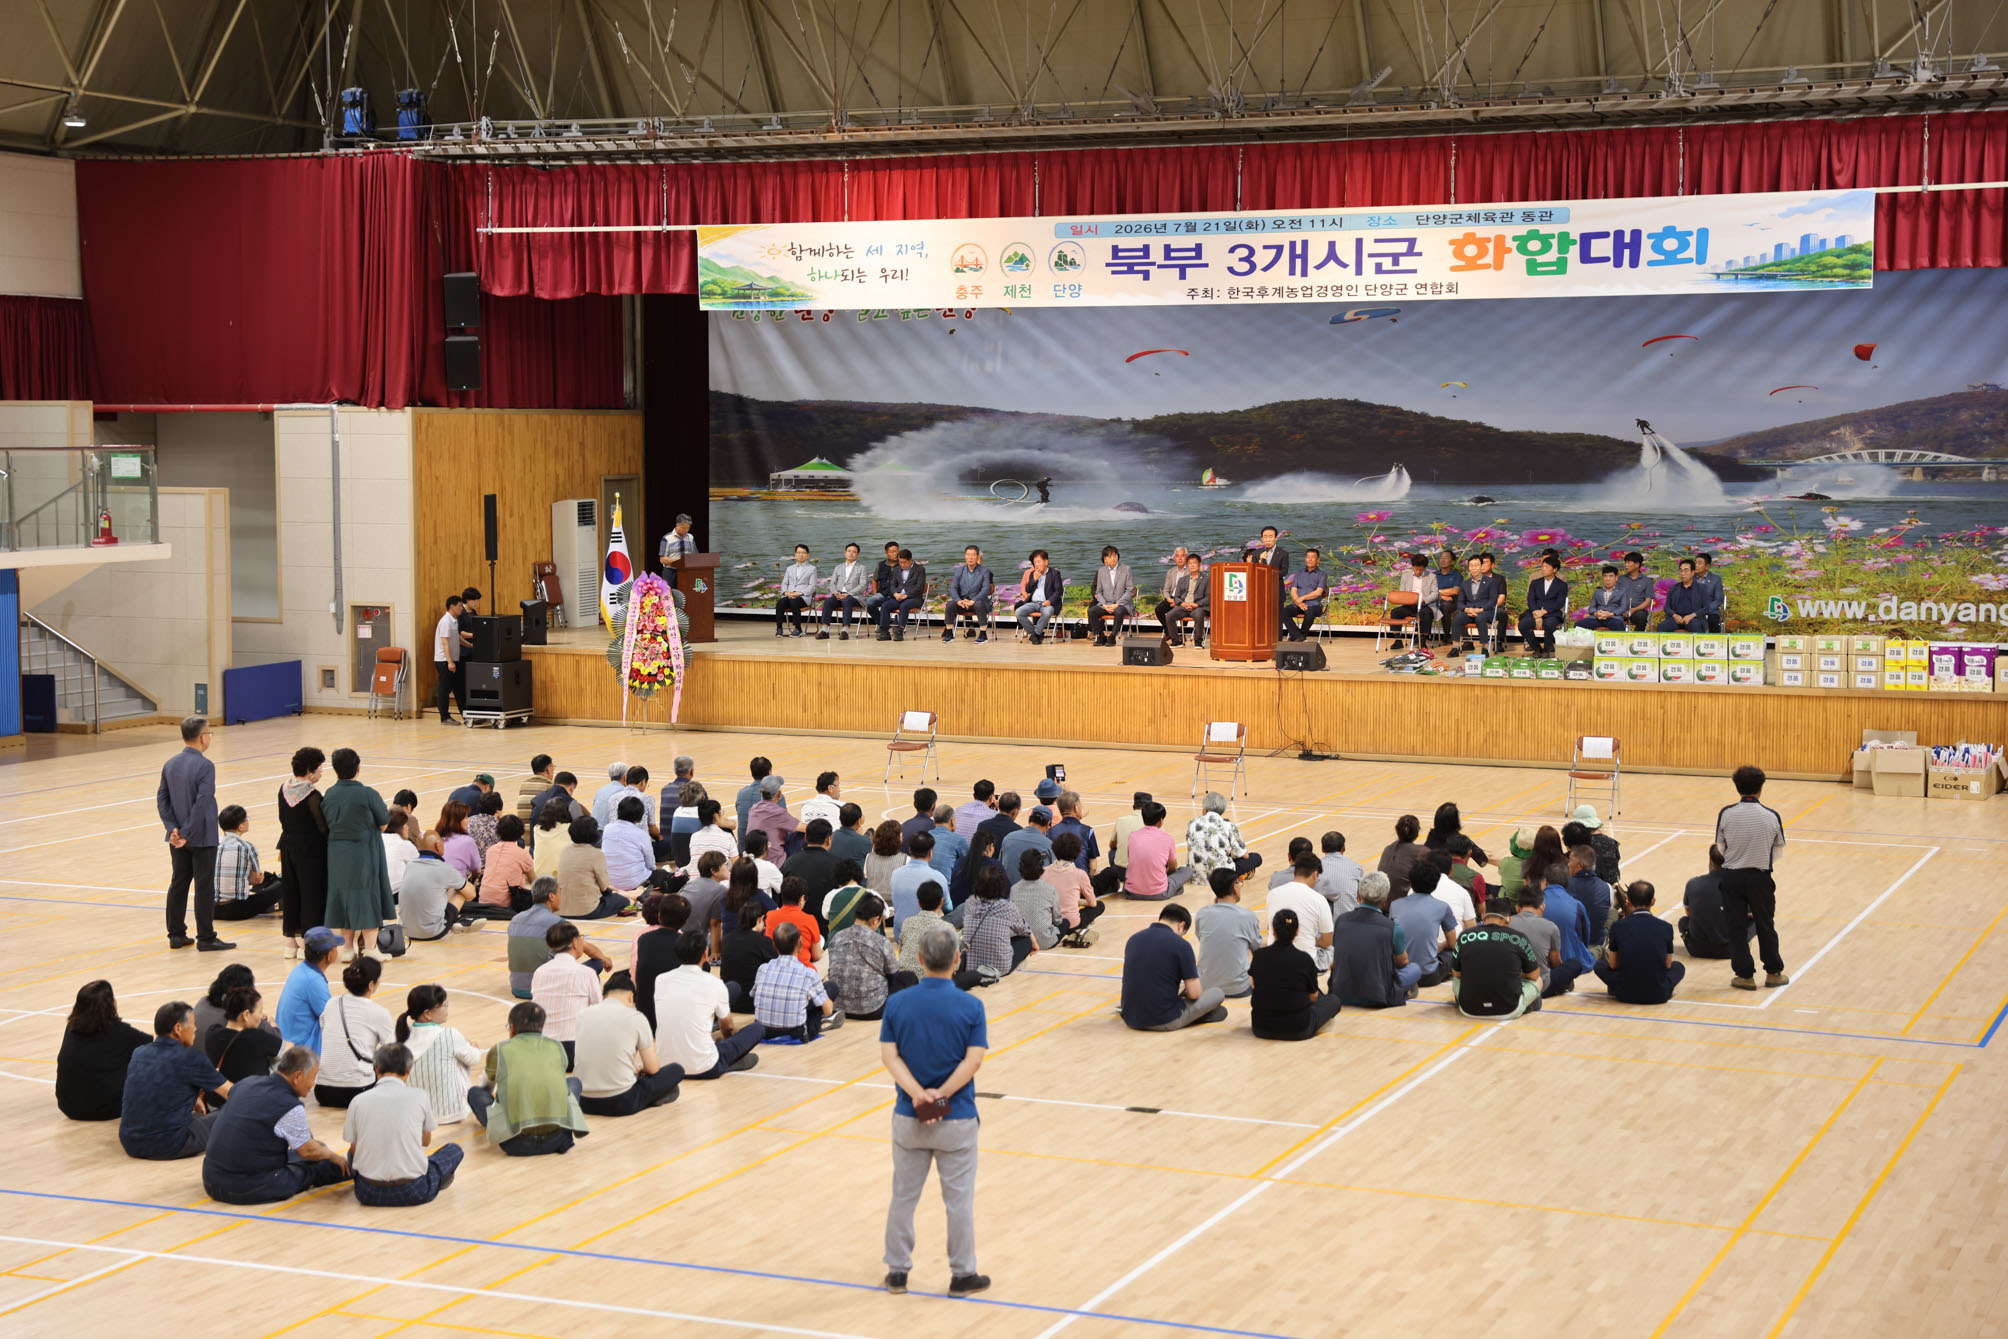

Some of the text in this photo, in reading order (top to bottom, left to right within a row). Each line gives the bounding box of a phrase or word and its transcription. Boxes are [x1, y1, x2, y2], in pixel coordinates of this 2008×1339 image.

[1114, 216, 1343, 234] 2026년 7월 21일(화) 오전 11시
[1368, 215, 1398, 228] 장소
[1416, 210, 1554, 226] 단양군체육관 동관
[1070, 224, 1098, 236] 일시
[788, 240, 928, 262] 함께하는 세 지역,
[1105, 225, 1710, 282] 북부 3개시군 화합대회
[807, 266, 909, 284] 하나되는 우리!
[955, 284, 984, 300] 충주
[1003, 284, 1032, 299] 제천
[1054, 283, 1082, 298] 단양
[1186, 281, 1459, 300] 주최: 한국후계농업경영인 단양군 연합회
[1932, 782, 1969, 791] EIDER
[1460, 931, 1488, 944] COQ
